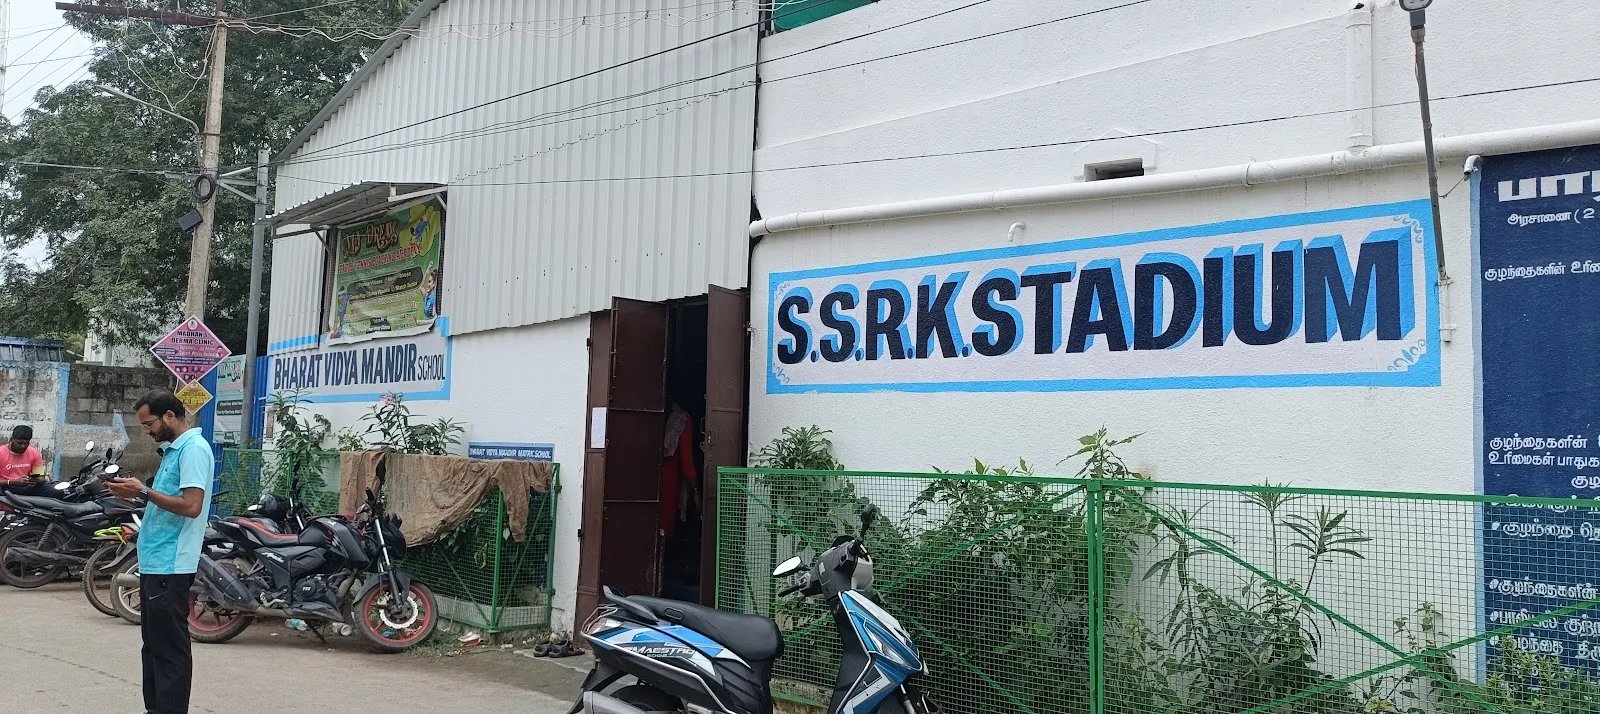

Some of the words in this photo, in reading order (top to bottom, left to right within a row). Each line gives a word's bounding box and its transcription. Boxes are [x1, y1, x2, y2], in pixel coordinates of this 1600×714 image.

[1485, 262, 1566, 281] குழந்தைகளின்
[274, 352, 323, 390] BHARAT
[324, 349, 358, 386] VIDYA
[360, 343, 417, 385] MANDIR
[417, 354, 446, 381] SCHOOL
[1490, 433, 1588, 450] குழந்தைகளின்
[1488, 451, 1555, 465] உரிமைகள்
[632, 645, 696, 656] MAESTRO
